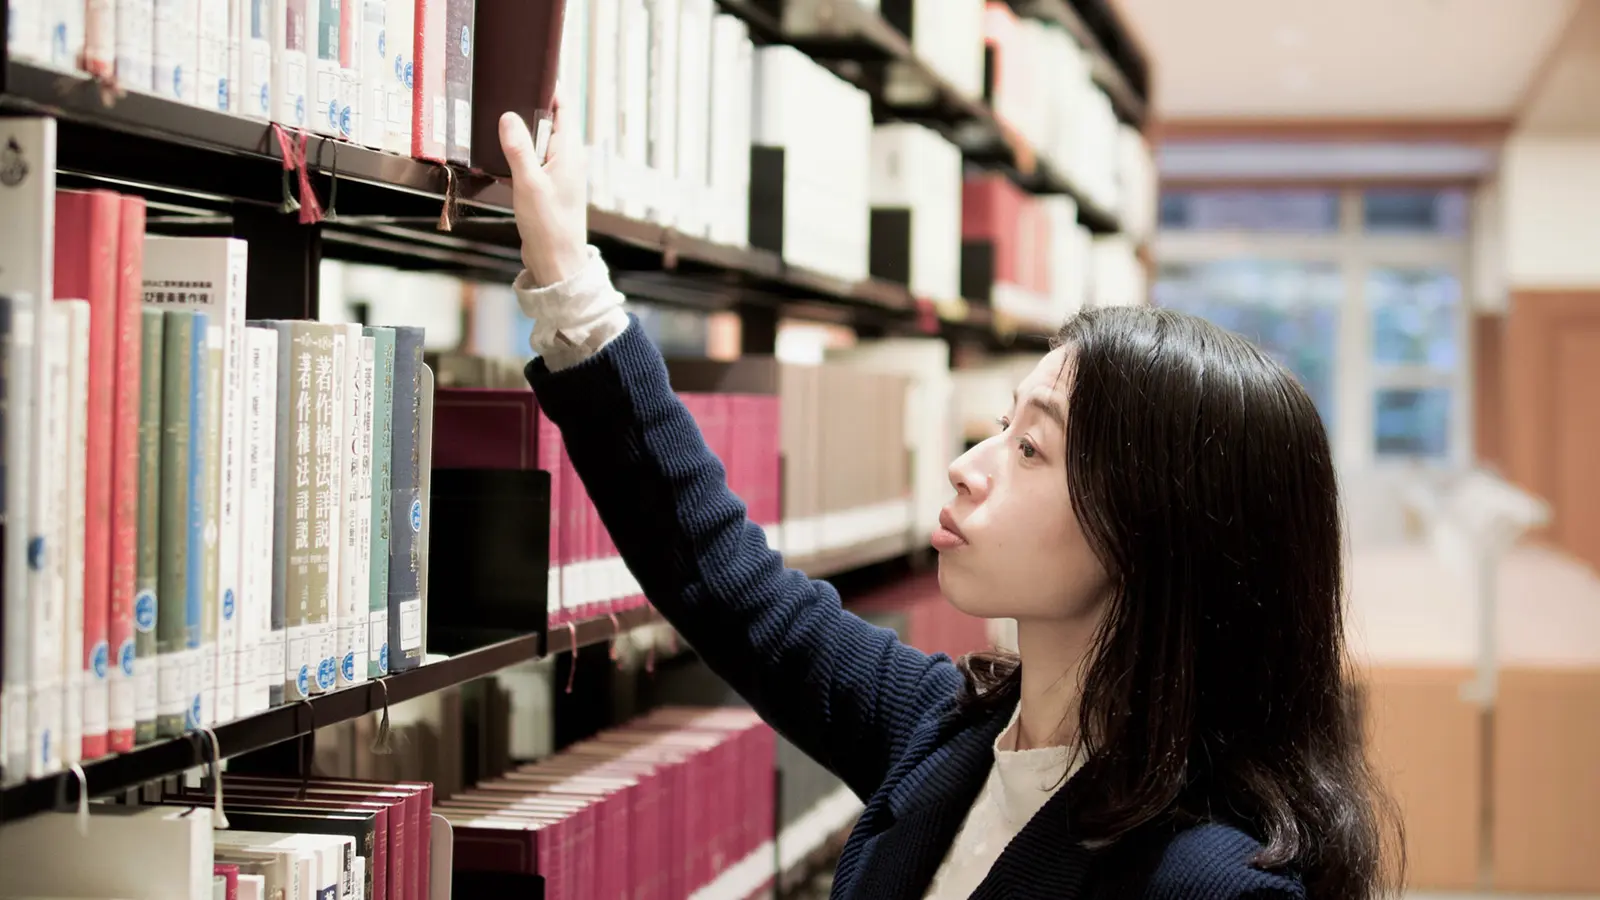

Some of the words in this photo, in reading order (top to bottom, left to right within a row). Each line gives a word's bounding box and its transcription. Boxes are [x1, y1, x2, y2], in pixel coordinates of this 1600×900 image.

[295, 352, 312, 550] 著作権法詳説
[315, 355, 332, 549] 著作権法詳説
